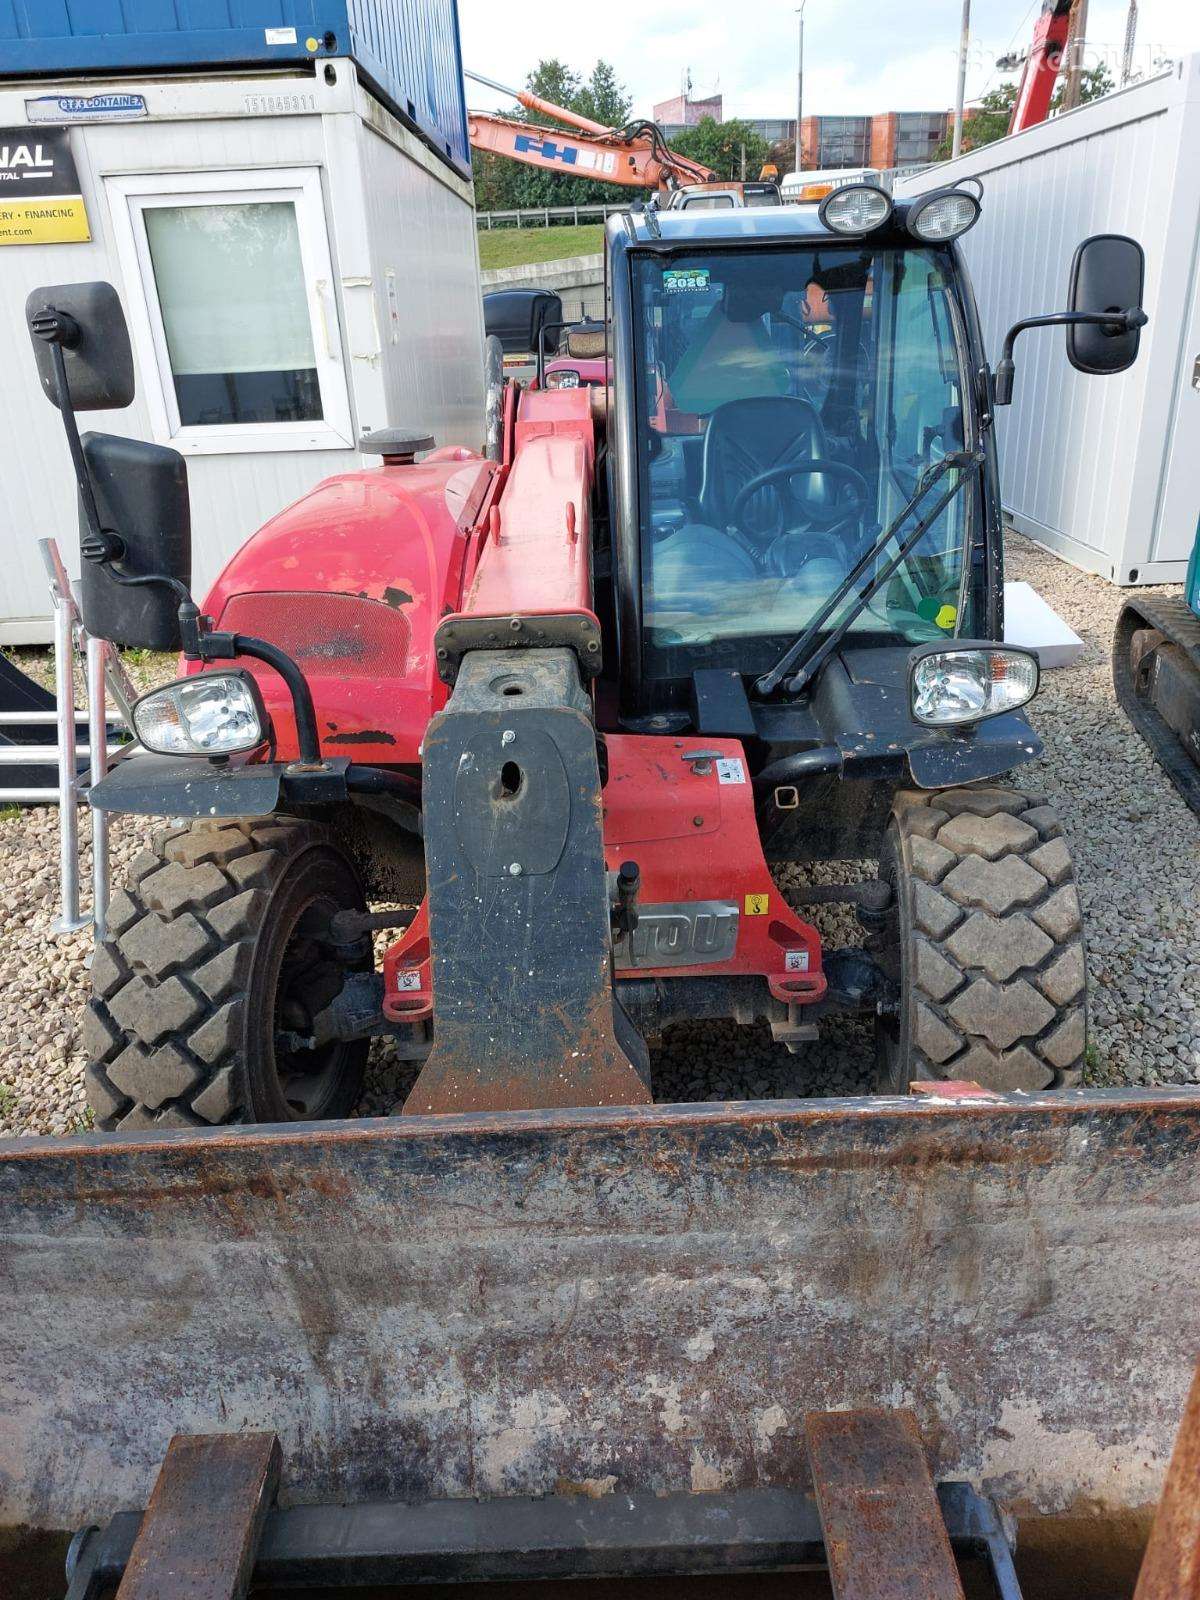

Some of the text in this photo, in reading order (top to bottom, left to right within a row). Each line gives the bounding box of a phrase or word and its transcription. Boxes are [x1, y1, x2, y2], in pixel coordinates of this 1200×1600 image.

[86, 95, 143, 108] CONTAINEX
[25, 208, 74, 219] FINANCING
[667, 276, 707, 288] 2026
